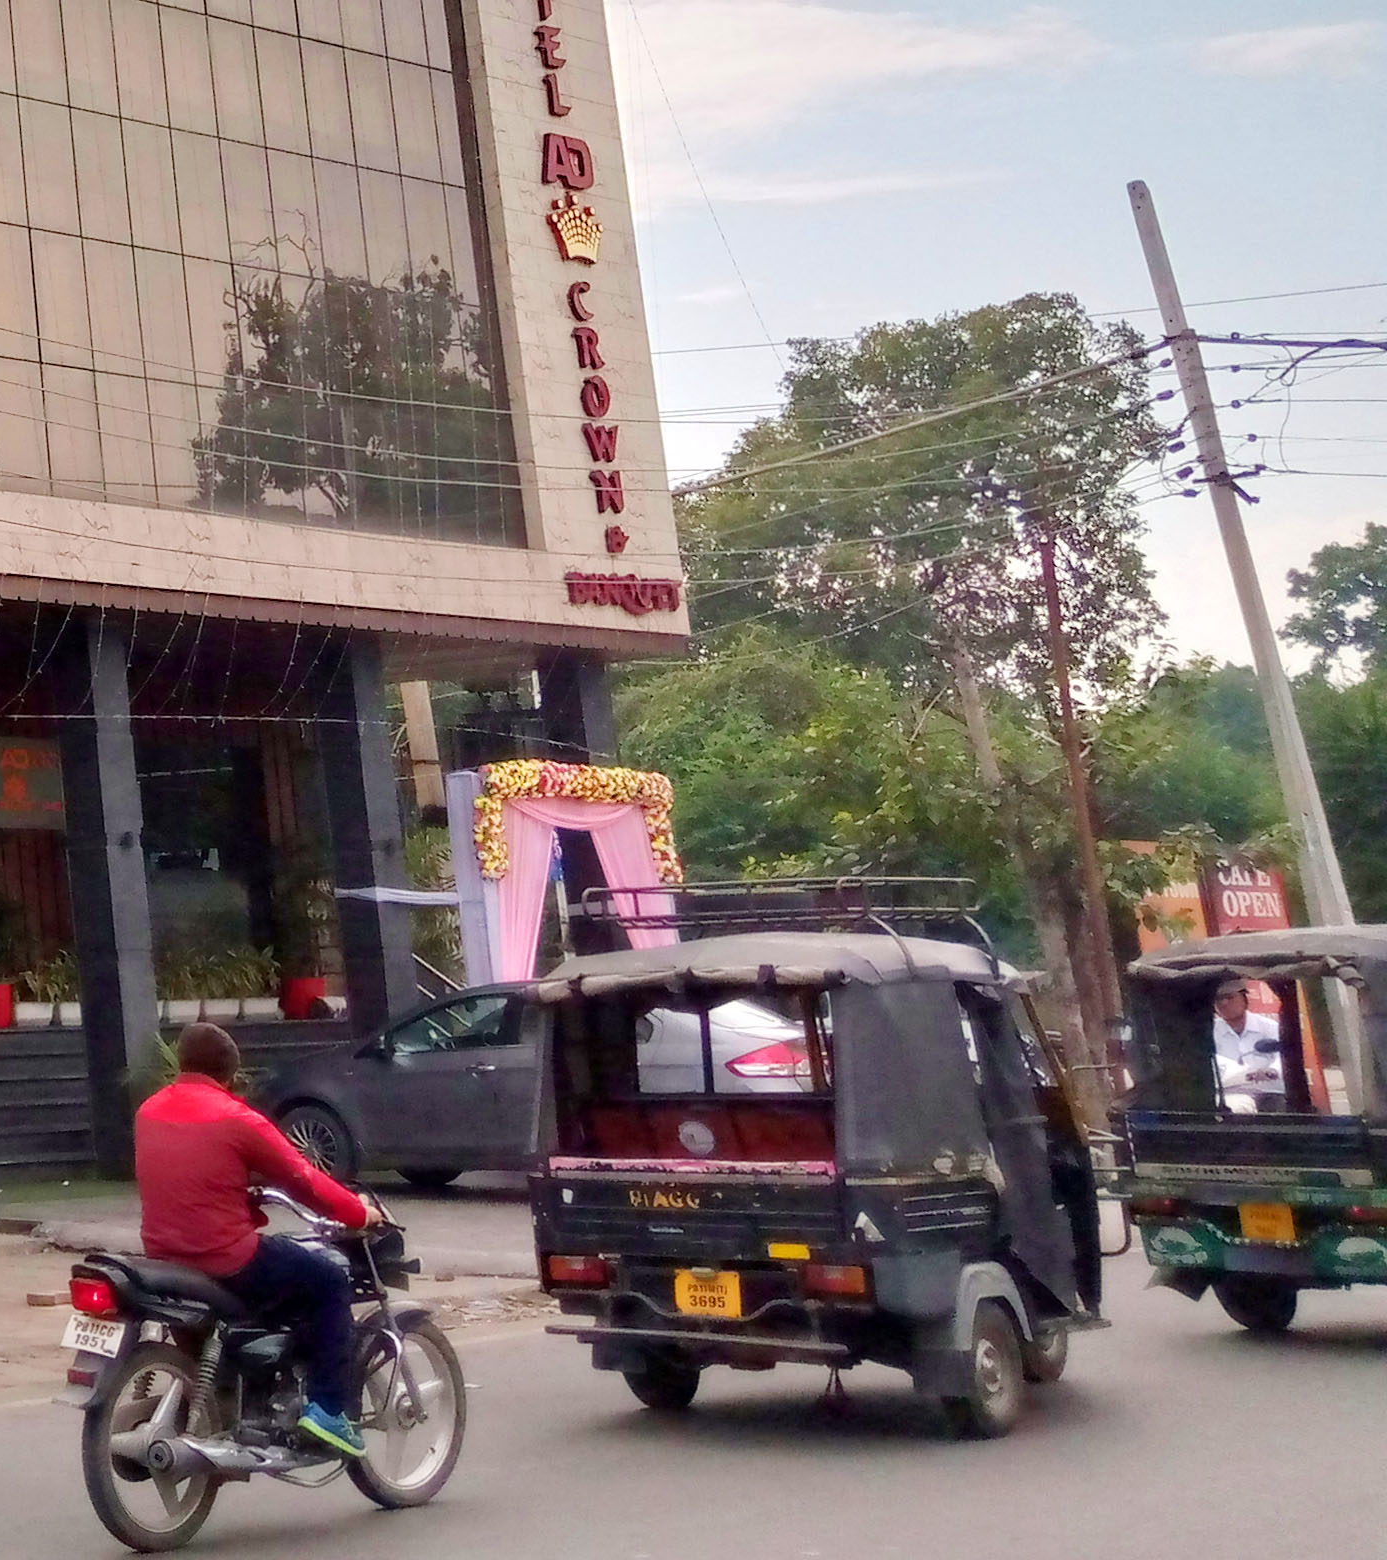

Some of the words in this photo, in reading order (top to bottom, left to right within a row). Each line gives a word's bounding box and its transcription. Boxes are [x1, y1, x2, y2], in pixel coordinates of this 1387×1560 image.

[541, 132, 595, 191] AD
[567, 280, 625, 514] CROWN
[1221, 890, 1283, 918] OPEN
[689, 1294, 726, 1308] 3695
